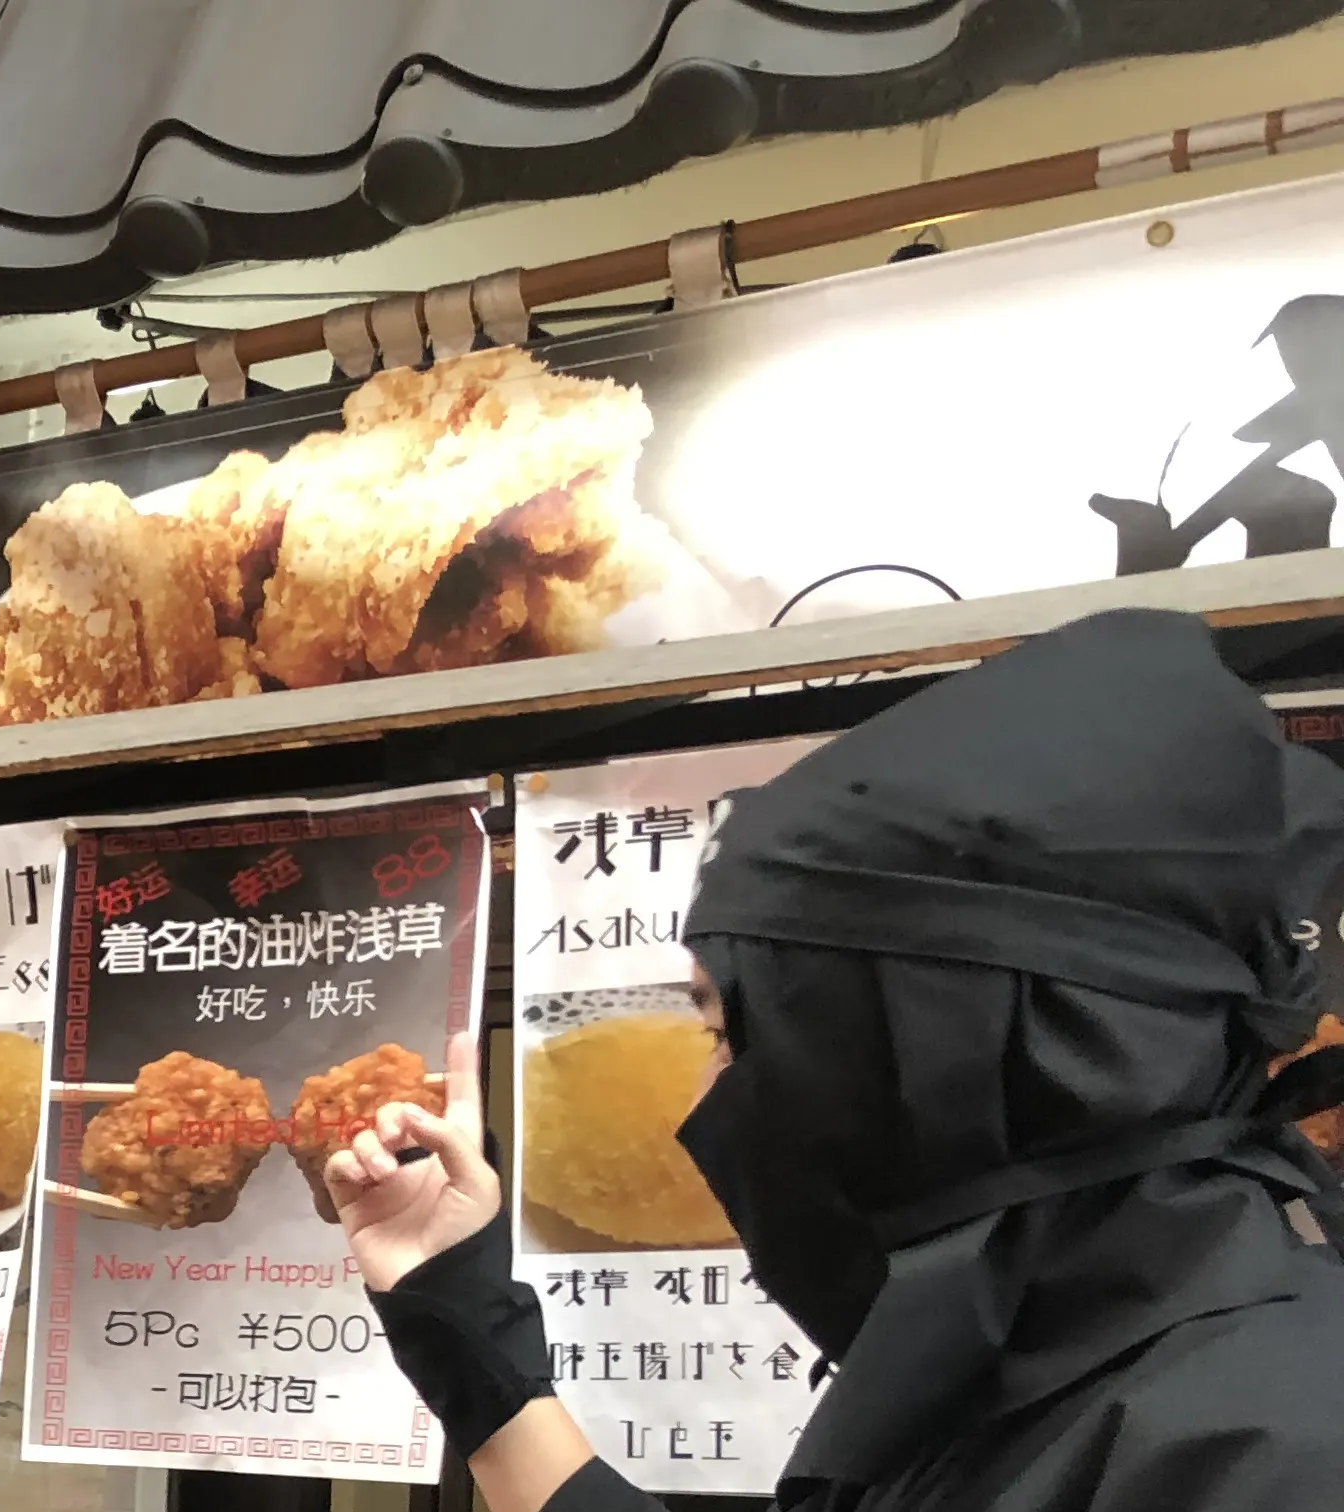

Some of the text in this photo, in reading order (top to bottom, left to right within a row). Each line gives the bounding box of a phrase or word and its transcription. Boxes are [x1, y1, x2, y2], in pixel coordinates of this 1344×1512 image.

[371, 834, 452, 898] 88
[98, 901, 447, 976] 着名的油炸浅草
[526, 907, 680, 955] Asaku
[92, 1254, 155, 1282] New
[164, 1255, 237, 1283] Year
[244, 1255, 334, 1289] Happy
